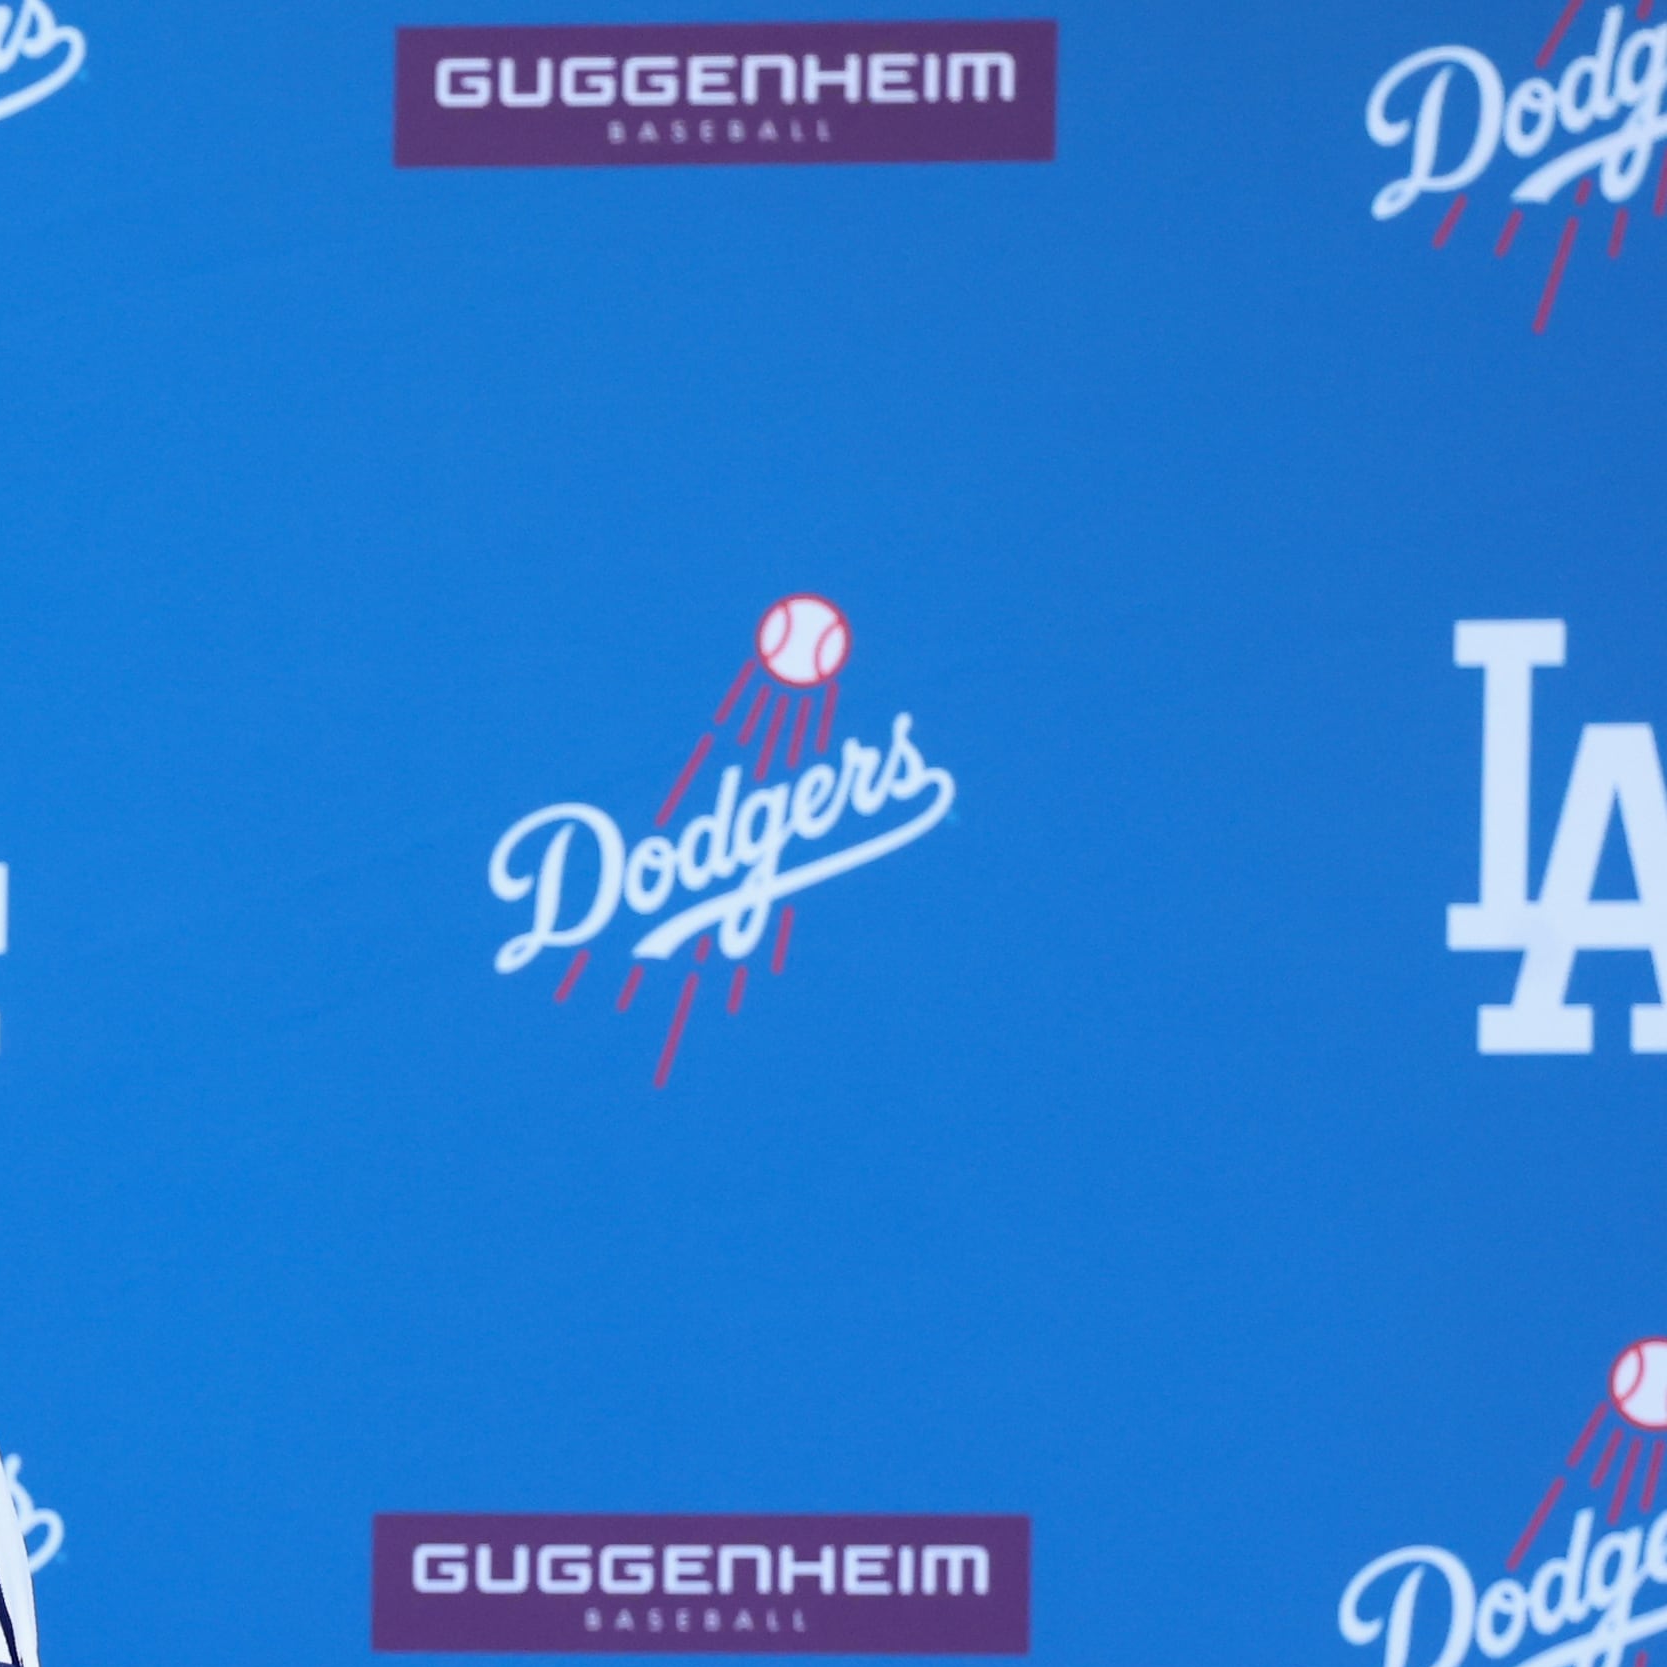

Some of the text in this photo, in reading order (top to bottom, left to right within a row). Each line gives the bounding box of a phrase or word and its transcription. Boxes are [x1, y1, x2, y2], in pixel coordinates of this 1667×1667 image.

[434, 51, 1017, 107] GUGGENHEIM
[607, 119, 831, 145] BASEBALL
[1368, 6, 1667, 218] Dodg
[489, 713, 955, 973] Dodgers
[1447, 619, 1667, 1054] LA
[412, 1542, 991, 1597] GUGGENHEIM
[584, 1608, 806, 1633] BASEBALL
